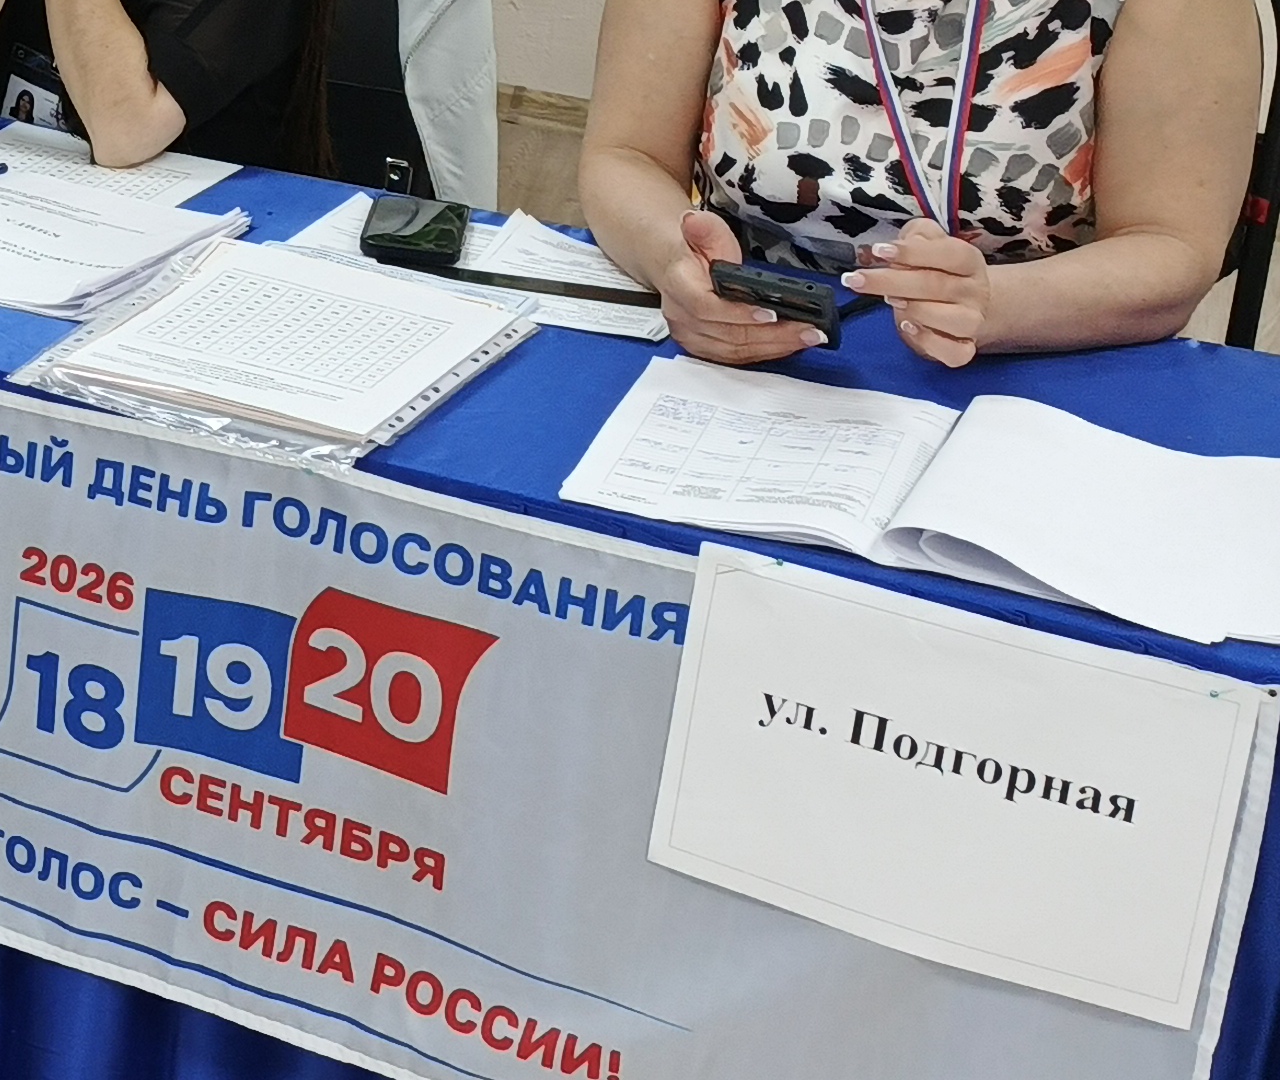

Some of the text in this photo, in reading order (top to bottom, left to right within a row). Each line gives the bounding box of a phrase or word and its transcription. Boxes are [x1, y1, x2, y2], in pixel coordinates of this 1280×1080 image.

[19, 546, 136, 612] 2026
[87, 458, 227, 526] ДЕНЬ
[241, 491, 688, 646] ГОЛОСОВАНИЯ
[24, 625, 441, 750] 18 19 20
[757, 690, 1138, 826] ул. Подгорная
[158, 765, 446, 891] СЕНТЯБРЯ
[202, 898, 354, 987] СИЛА
[369, 952, 622, 1080] РОССИИ!
